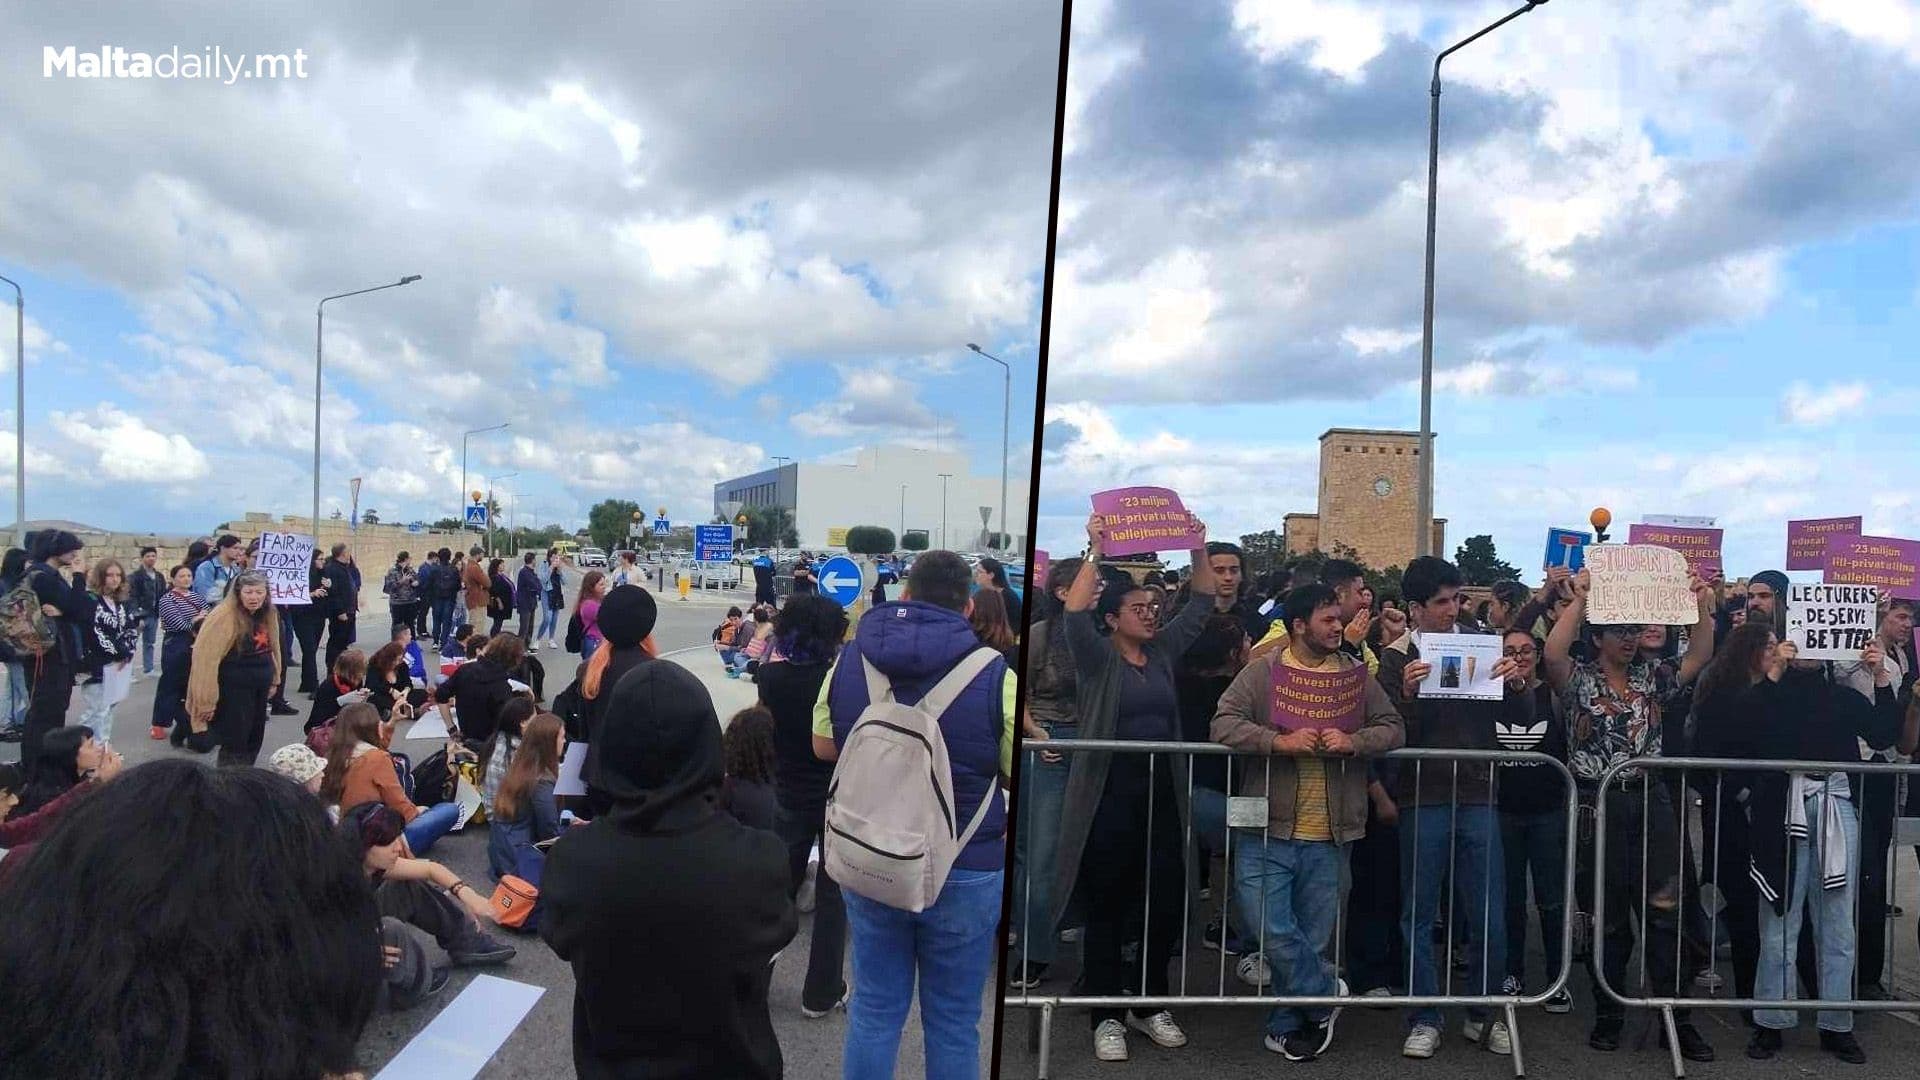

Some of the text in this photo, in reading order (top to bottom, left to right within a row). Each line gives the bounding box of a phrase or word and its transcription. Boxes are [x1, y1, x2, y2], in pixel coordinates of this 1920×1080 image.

[262, 532, 313, 552] FAIR PAY
[1672, 535, 1710, 545] FUTURE
[1695, 549, 1719, 558] HELD
[278, 570, 306, 582] MORE
[1600, 573, 1628, 583] WIN
[1593, 585, 1698, 611] LECTURERS
[1792, 586, 1877, 604] LECTURERS
[1806, 608, 1866, 625] DESERVE
[1806, 628, 1873, 650] BETTER
[1276, 698, 1286, 709] in
[1287, 704, 1307, 716] our
